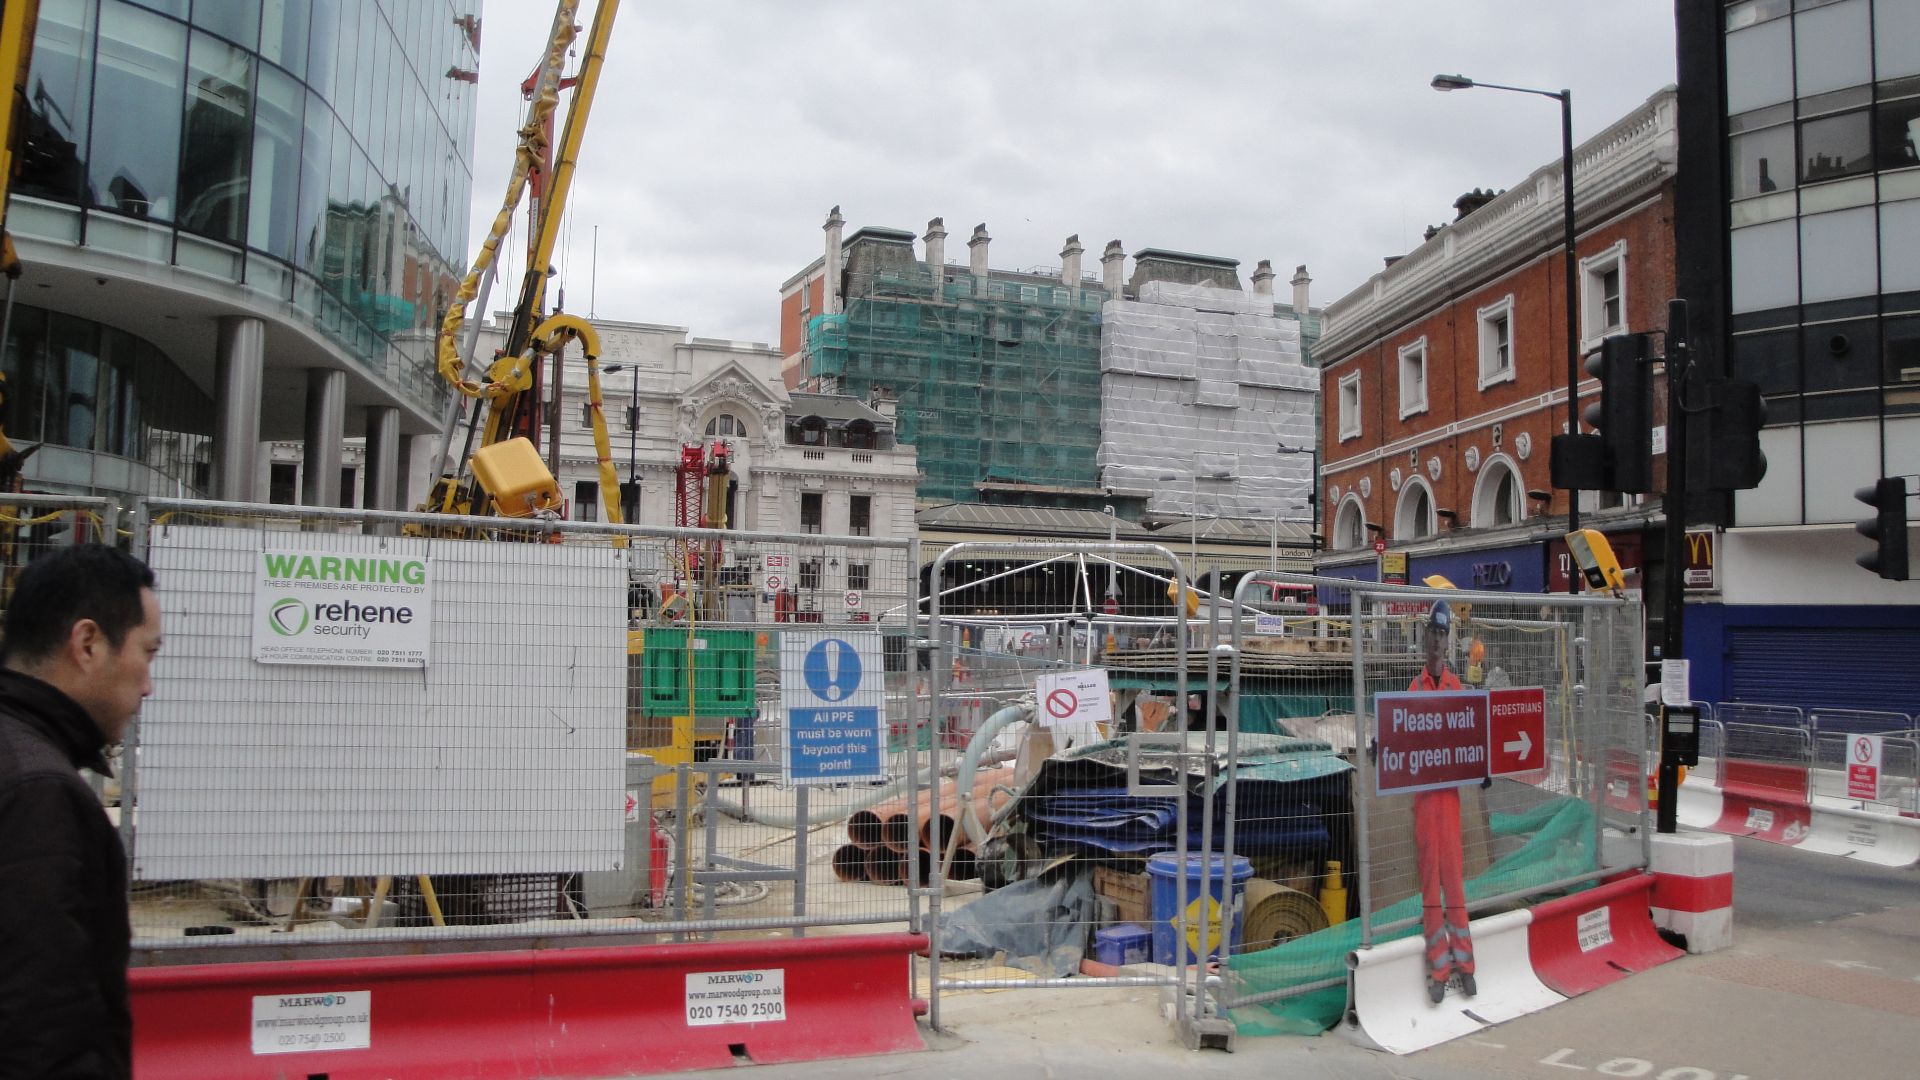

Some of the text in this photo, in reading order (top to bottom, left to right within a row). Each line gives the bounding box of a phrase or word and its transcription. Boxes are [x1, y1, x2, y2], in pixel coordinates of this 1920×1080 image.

[1281, 549, 1306, 557] London
[265, 553, 426, 585] WARNING
[263, 580, 425, 594] THESE PREMISES ARE PROTECTED BY
[314, 600, 413, 624] rehene
[313, 624, 371, 640] security
[1492, 701, 1542, 716] PEDESTRIANS
[813, 711, 855, 723] All PPE
[1392, 706, 1475, 733] Please wait
[797, 728, 872, 739] must be worn
[802, 743, 867, 757] beyond this
[1382, 744, 1484, 775] for green man
[688, 985, 783, 1000] www.marwoodgroup.co.uk
[689, 1001, 782, 1019] 020 7540 2500
[1537, 1047, 1750, 1080] LOO
